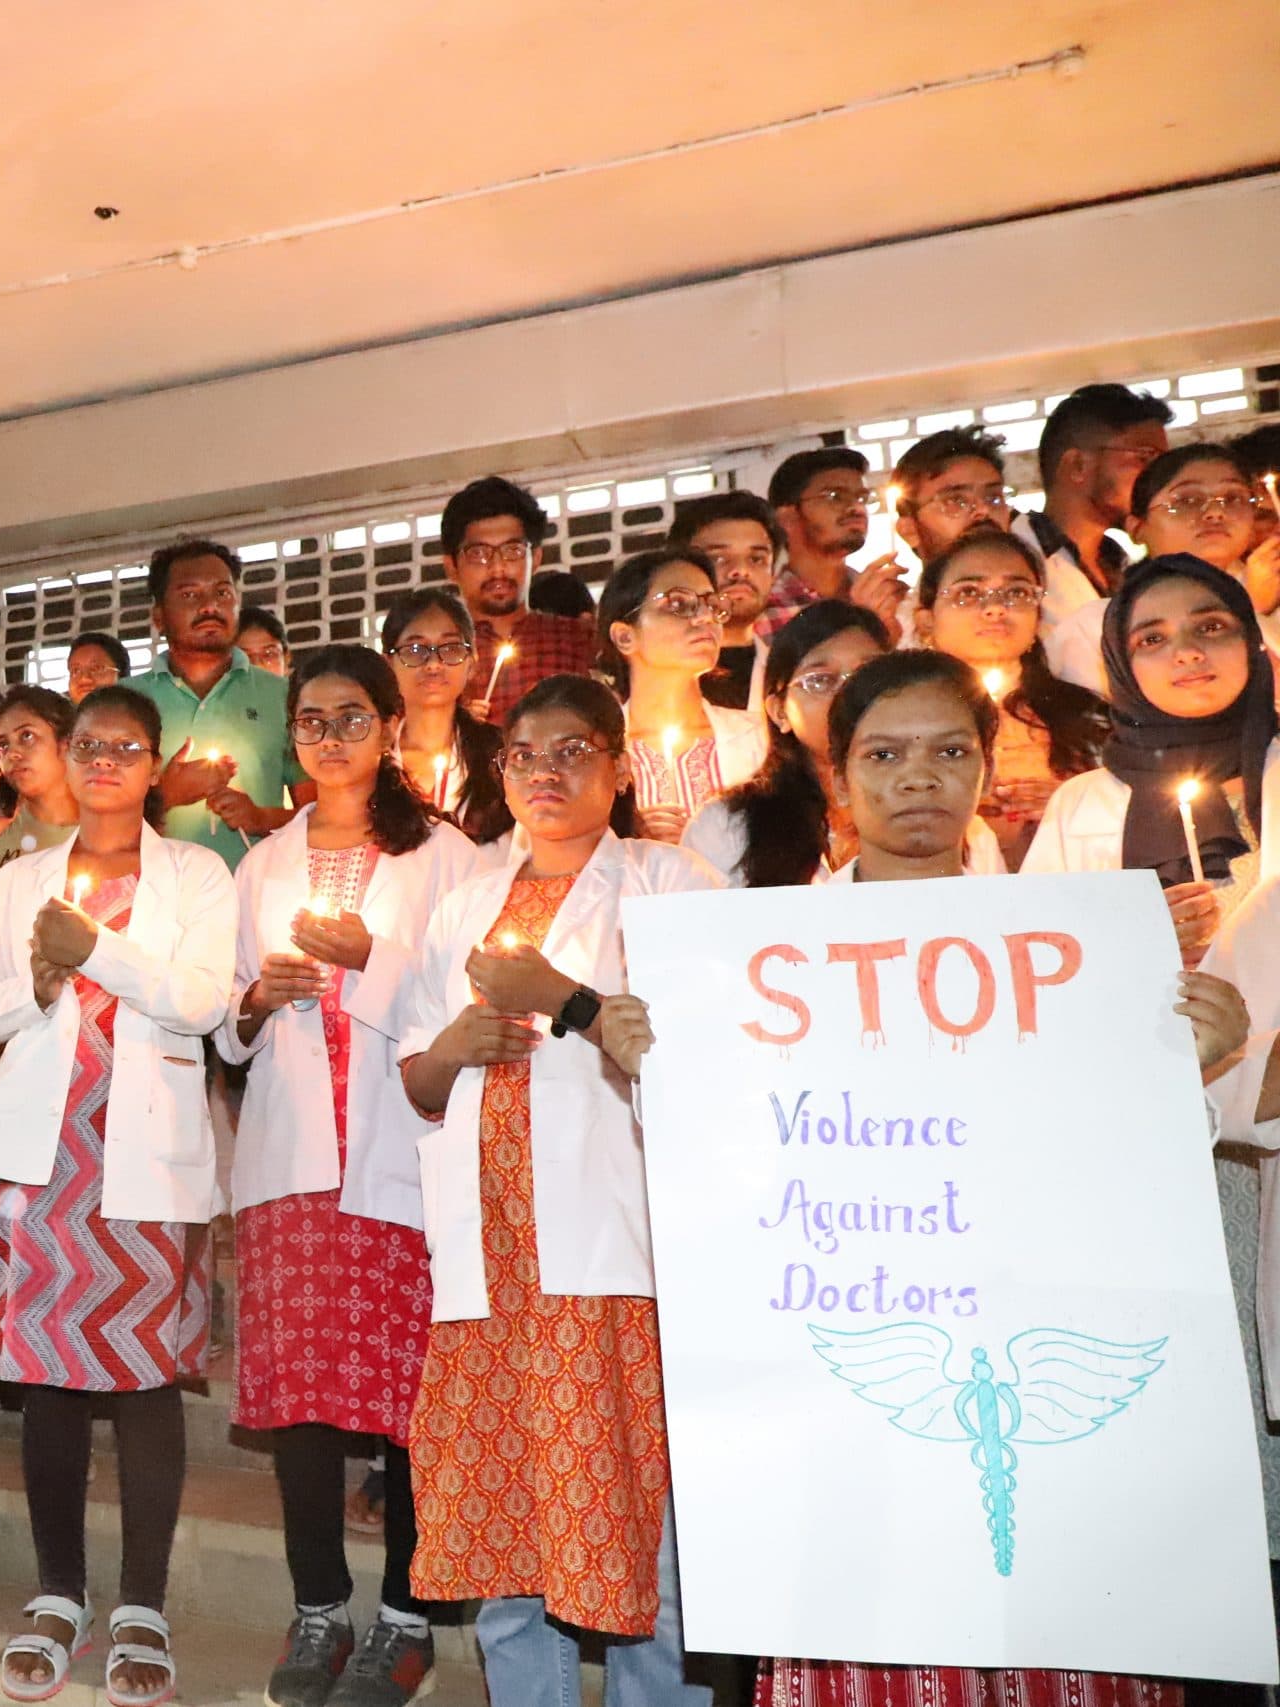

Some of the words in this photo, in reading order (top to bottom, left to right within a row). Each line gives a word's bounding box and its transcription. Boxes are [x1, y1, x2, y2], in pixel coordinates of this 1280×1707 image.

[740, 931, 1083, 1055] STOP
[768, 1091, 968, 1147] Violence
[759, 1178, 971, 1254] Against
[769, 1263, 979, 1317] Doctors
